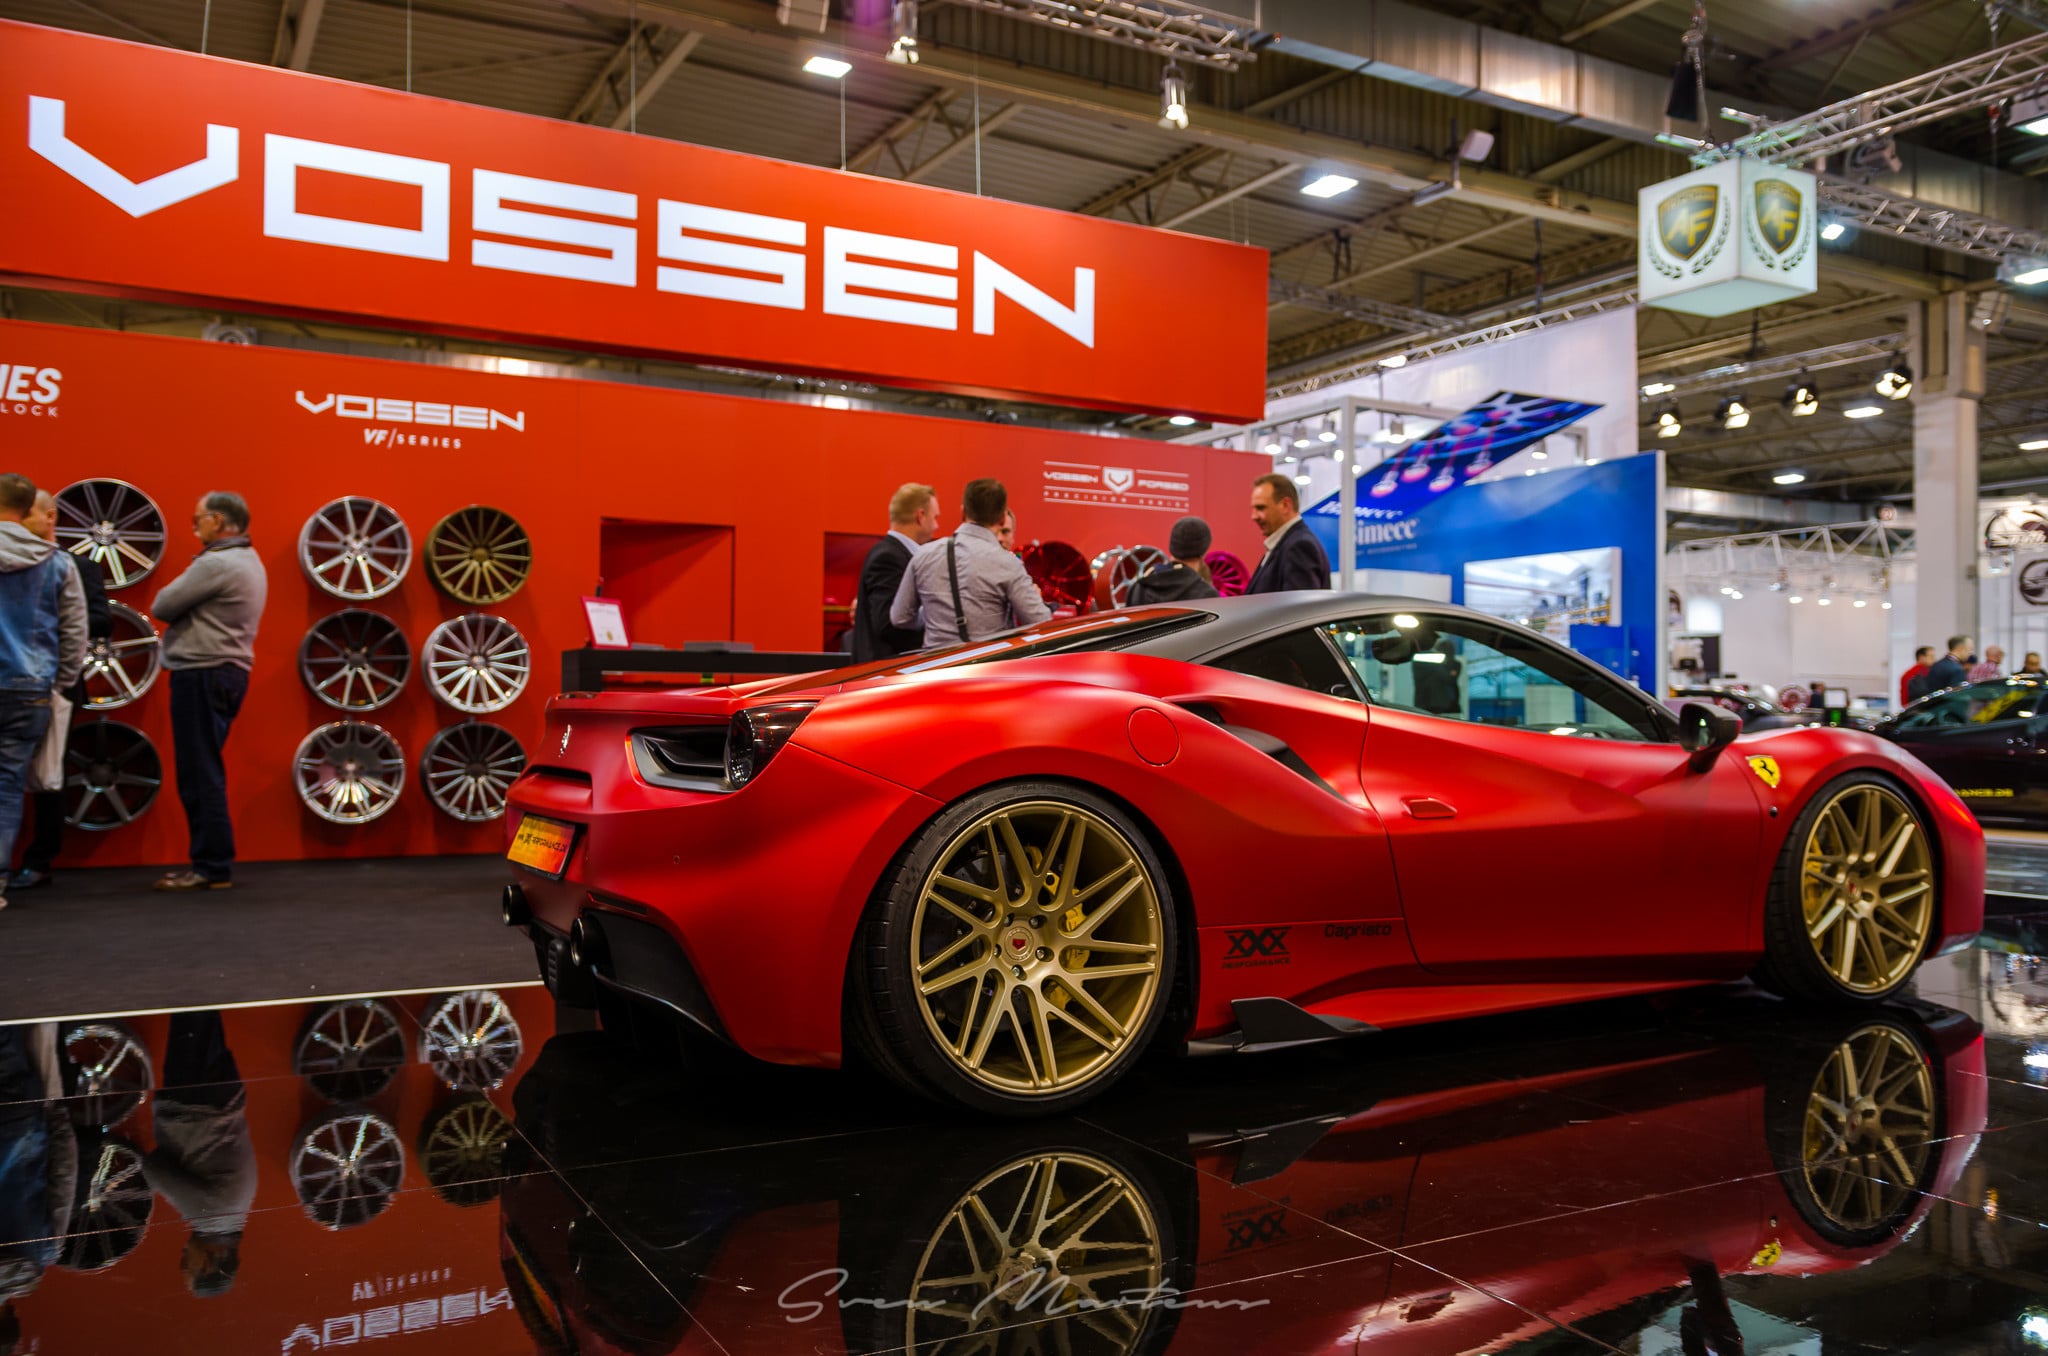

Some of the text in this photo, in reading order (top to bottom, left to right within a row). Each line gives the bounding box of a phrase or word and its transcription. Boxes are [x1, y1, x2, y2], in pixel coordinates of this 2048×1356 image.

[28, 94, 1096, 349] VOSSEN
[295, 390, 525, 432] VOSSEN
[1323, 922, 1393, 941] Capristo
[1221, 956, 1291, 970] PERFORMANCE
